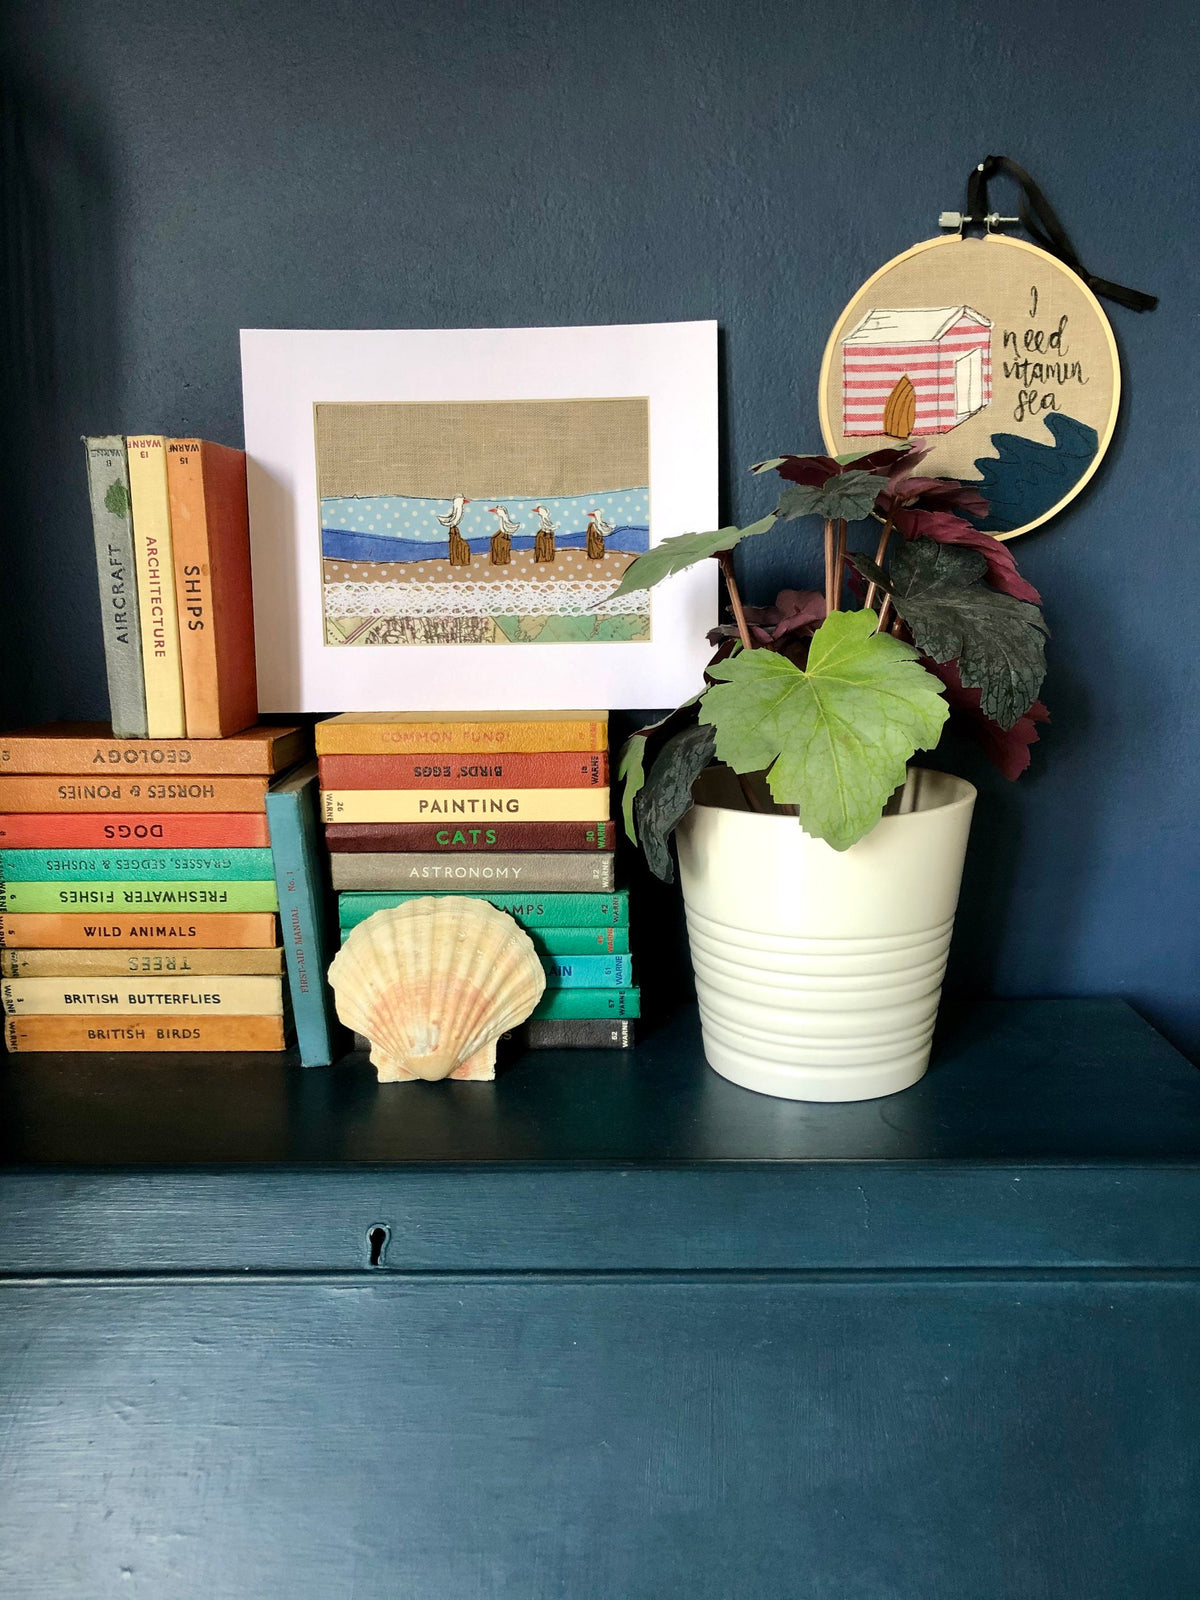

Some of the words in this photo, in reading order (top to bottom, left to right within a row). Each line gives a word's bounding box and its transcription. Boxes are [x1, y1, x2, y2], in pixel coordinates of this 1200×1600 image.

[1029, 285, 1038, 318] I
[1003, 314, 1069, 358] need
[1003, 357, 1089, 388] vitamin
[1013, 389, 1062, 422] sea
[127, 439, 162, 449] WARNE
[167, 443, 200, 453] WARNE
[139, 450, 149, 459] 13
[179, 457, 188, 465] 15
[107, 544, 129, 644] AIRCRAFT
[145, 536, 166, 658] ARCHITECTURE
[183, 565, 204, 632] SHIPS
[381, 731, 453, 743] COMMON
[92, 749, 192, 764] GEOLOGY
[413, 766, 452, 778] EGGS
[456, 766, 503, 779] BIRDS'
[590, 755, 600, 785] WARNE
[57, 785, 121, 799] PONIES
[129, 785, 141, 798] &
[147, 785, 215, 799] HORSES
[325, 793, 334, 822] WARNE
[336, 802, 344, 812] 26
[418, 799, 520, 814] PAINTING
[103, 825, 164, 839] DOGS
[435, 829, 497, 845] CATS
[597, 822, 606, 849] WARNE
[46, 859, 96, 871] RUSHES
[102, 859, 109, 870] &
[116, 859, 166, 870] SEDGES
[170, 857, 232, 870] GRASSES,
[409, 866, 523, 880] ASTRONOMY
[602, 860, 610, 889] WARNE
[59, 890, 115, 903] FISHES
[124, 890, 228, 903] FRESHWATER
[601, 904, 609, 915] 42
[83, 926, 122, 938] WILD
[129, 926, 197, 938] ANIMALS
[290, 906, 303, 945] MANUAL
[129, 957, 192, 971] TREES
[615, 956, 623, 986] WARNE
[295, 949, 309, 994] FIRST-AID
[63, 993, 119, 1005] BRITISH
[128, 993, 222, 1005] BUTTERFLIES
[608, 999, 615, 1009] 57
[618, 990, 626, 1016] WARNE
[87, 1028, 146, 1040] BRITISH
[156, 1028, 201, 1040] BIRDS
